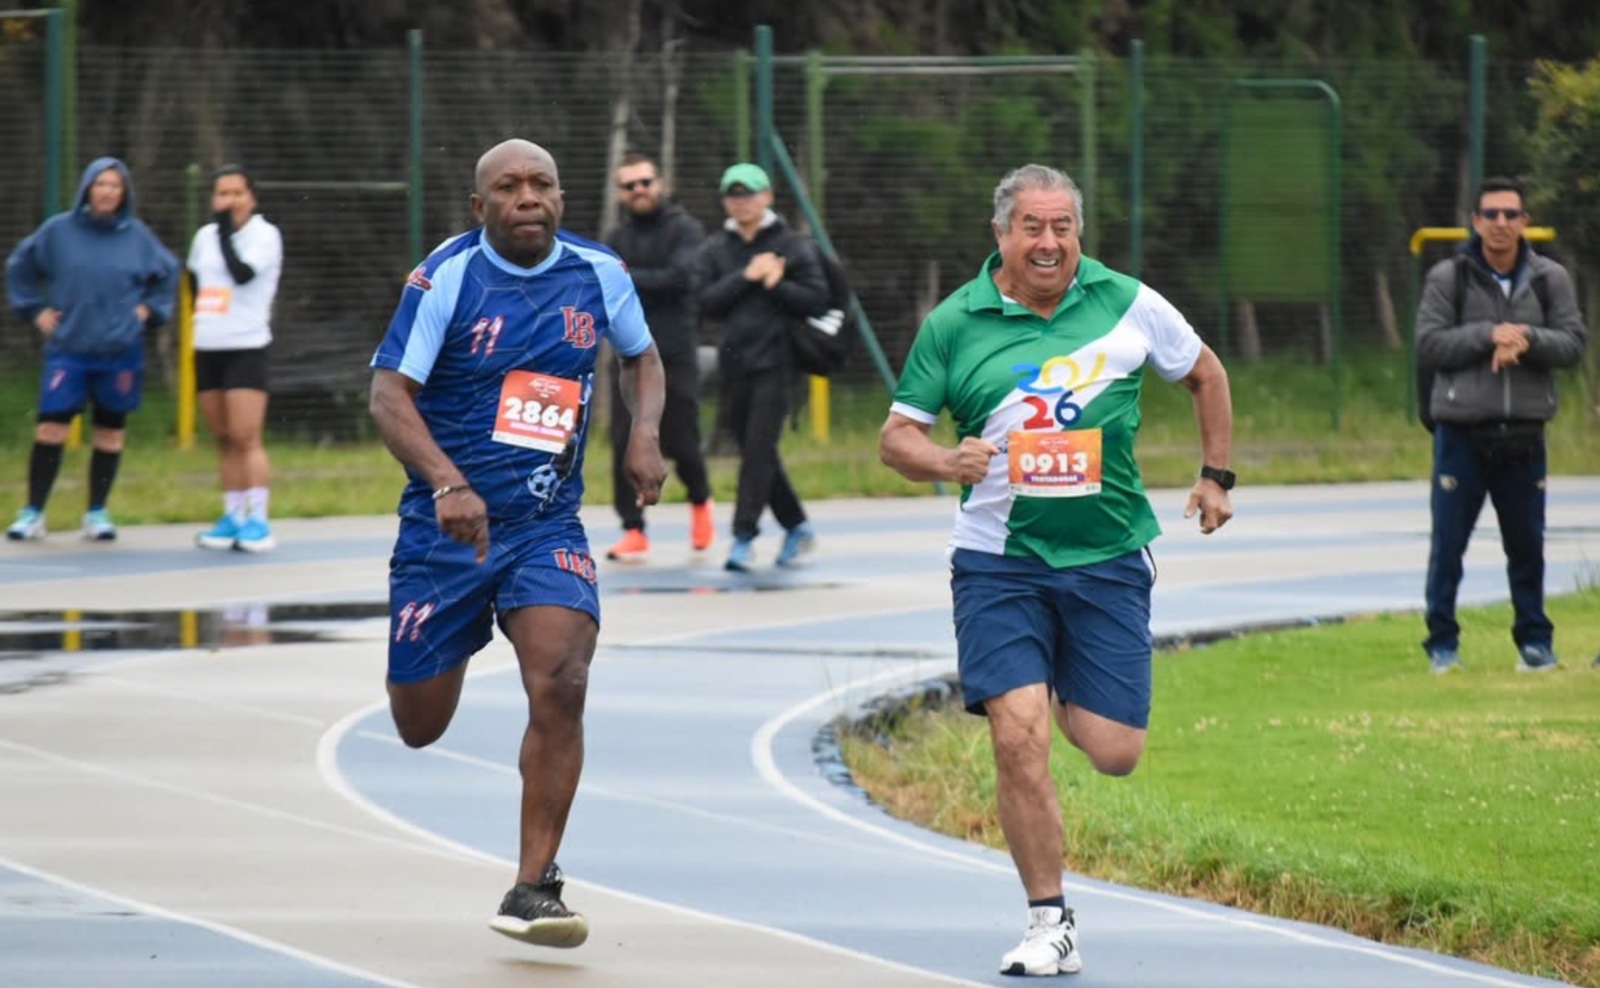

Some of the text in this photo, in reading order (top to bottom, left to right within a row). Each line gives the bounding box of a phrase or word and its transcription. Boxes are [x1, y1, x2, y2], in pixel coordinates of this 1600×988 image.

[470, 315, 505, 357] 11
[560, 306, 596, 349] LB
[502, 396, 575, 431] 2864
[1022, 390, 1082, 430] 26
[1020, 452, 1088, 473] 0913
